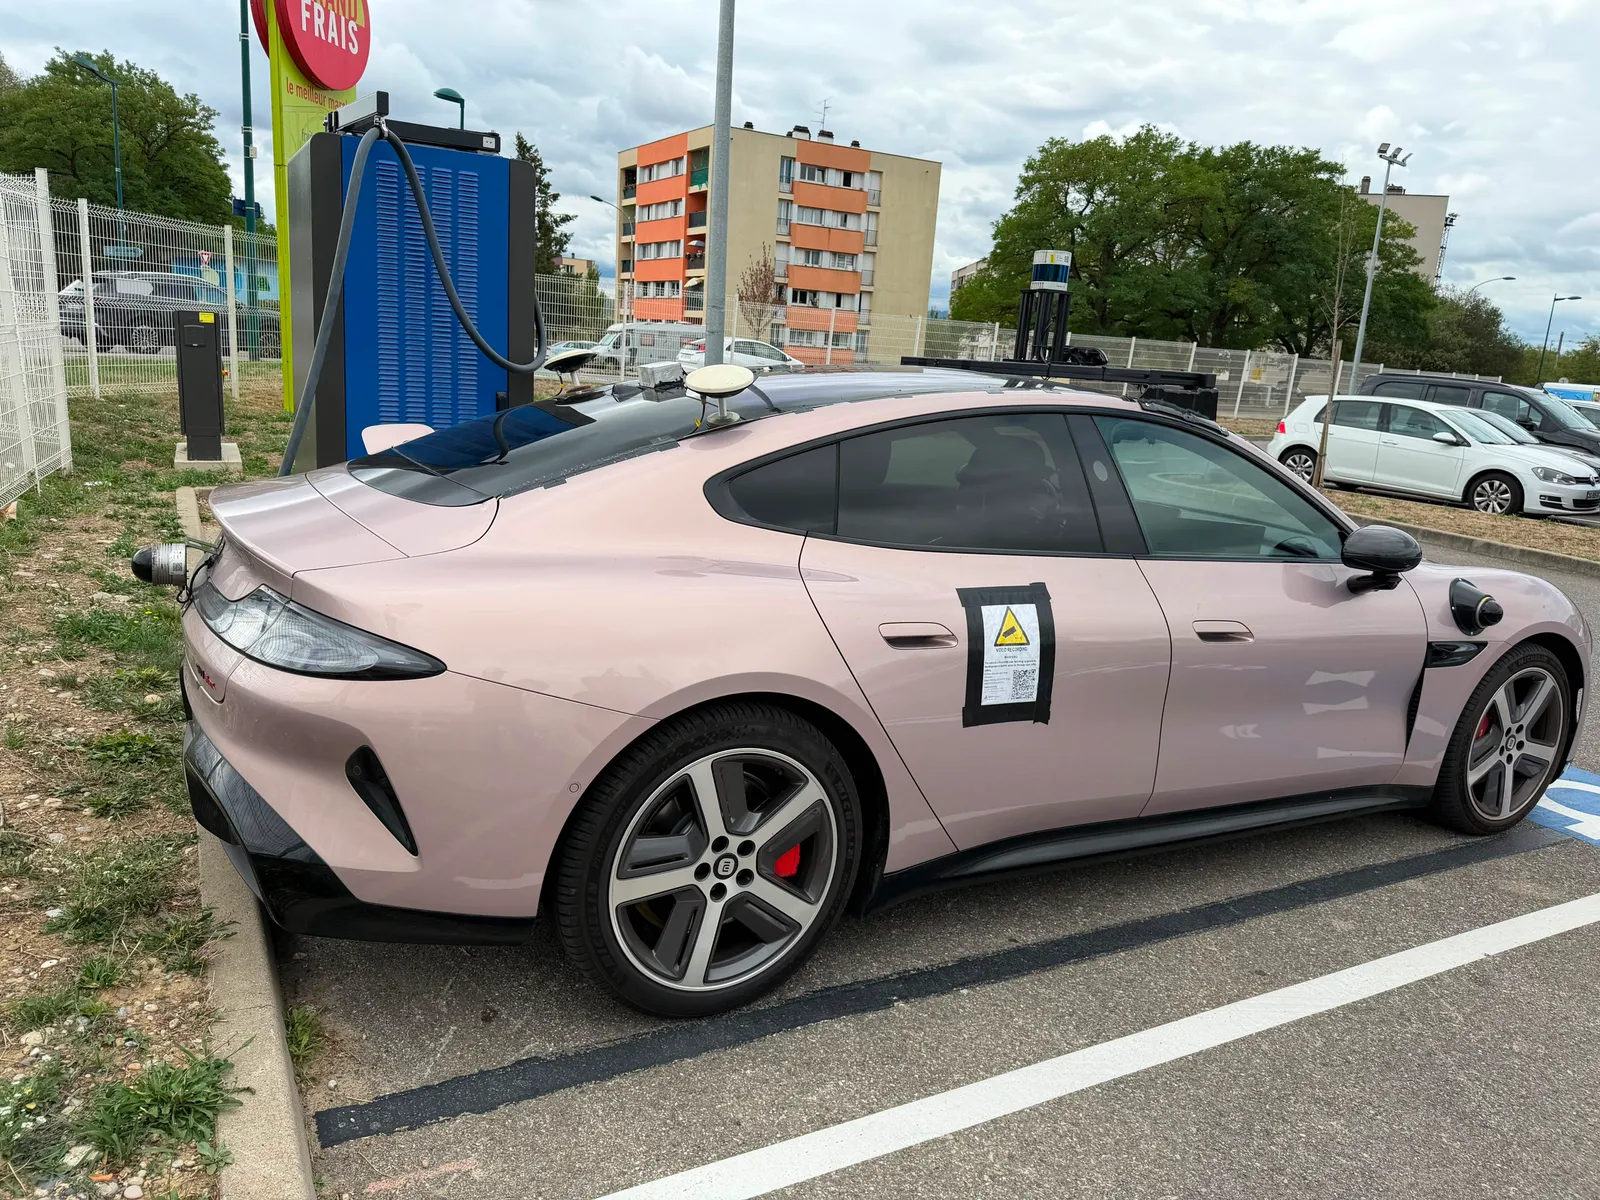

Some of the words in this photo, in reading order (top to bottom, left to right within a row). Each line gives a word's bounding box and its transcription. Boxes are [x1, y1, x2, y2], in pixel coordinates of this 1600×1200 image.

[301, 0, 358, 54] FRAIS
[286, 76, 294, 95] le
[295, 84, 327, 106] meilleur
